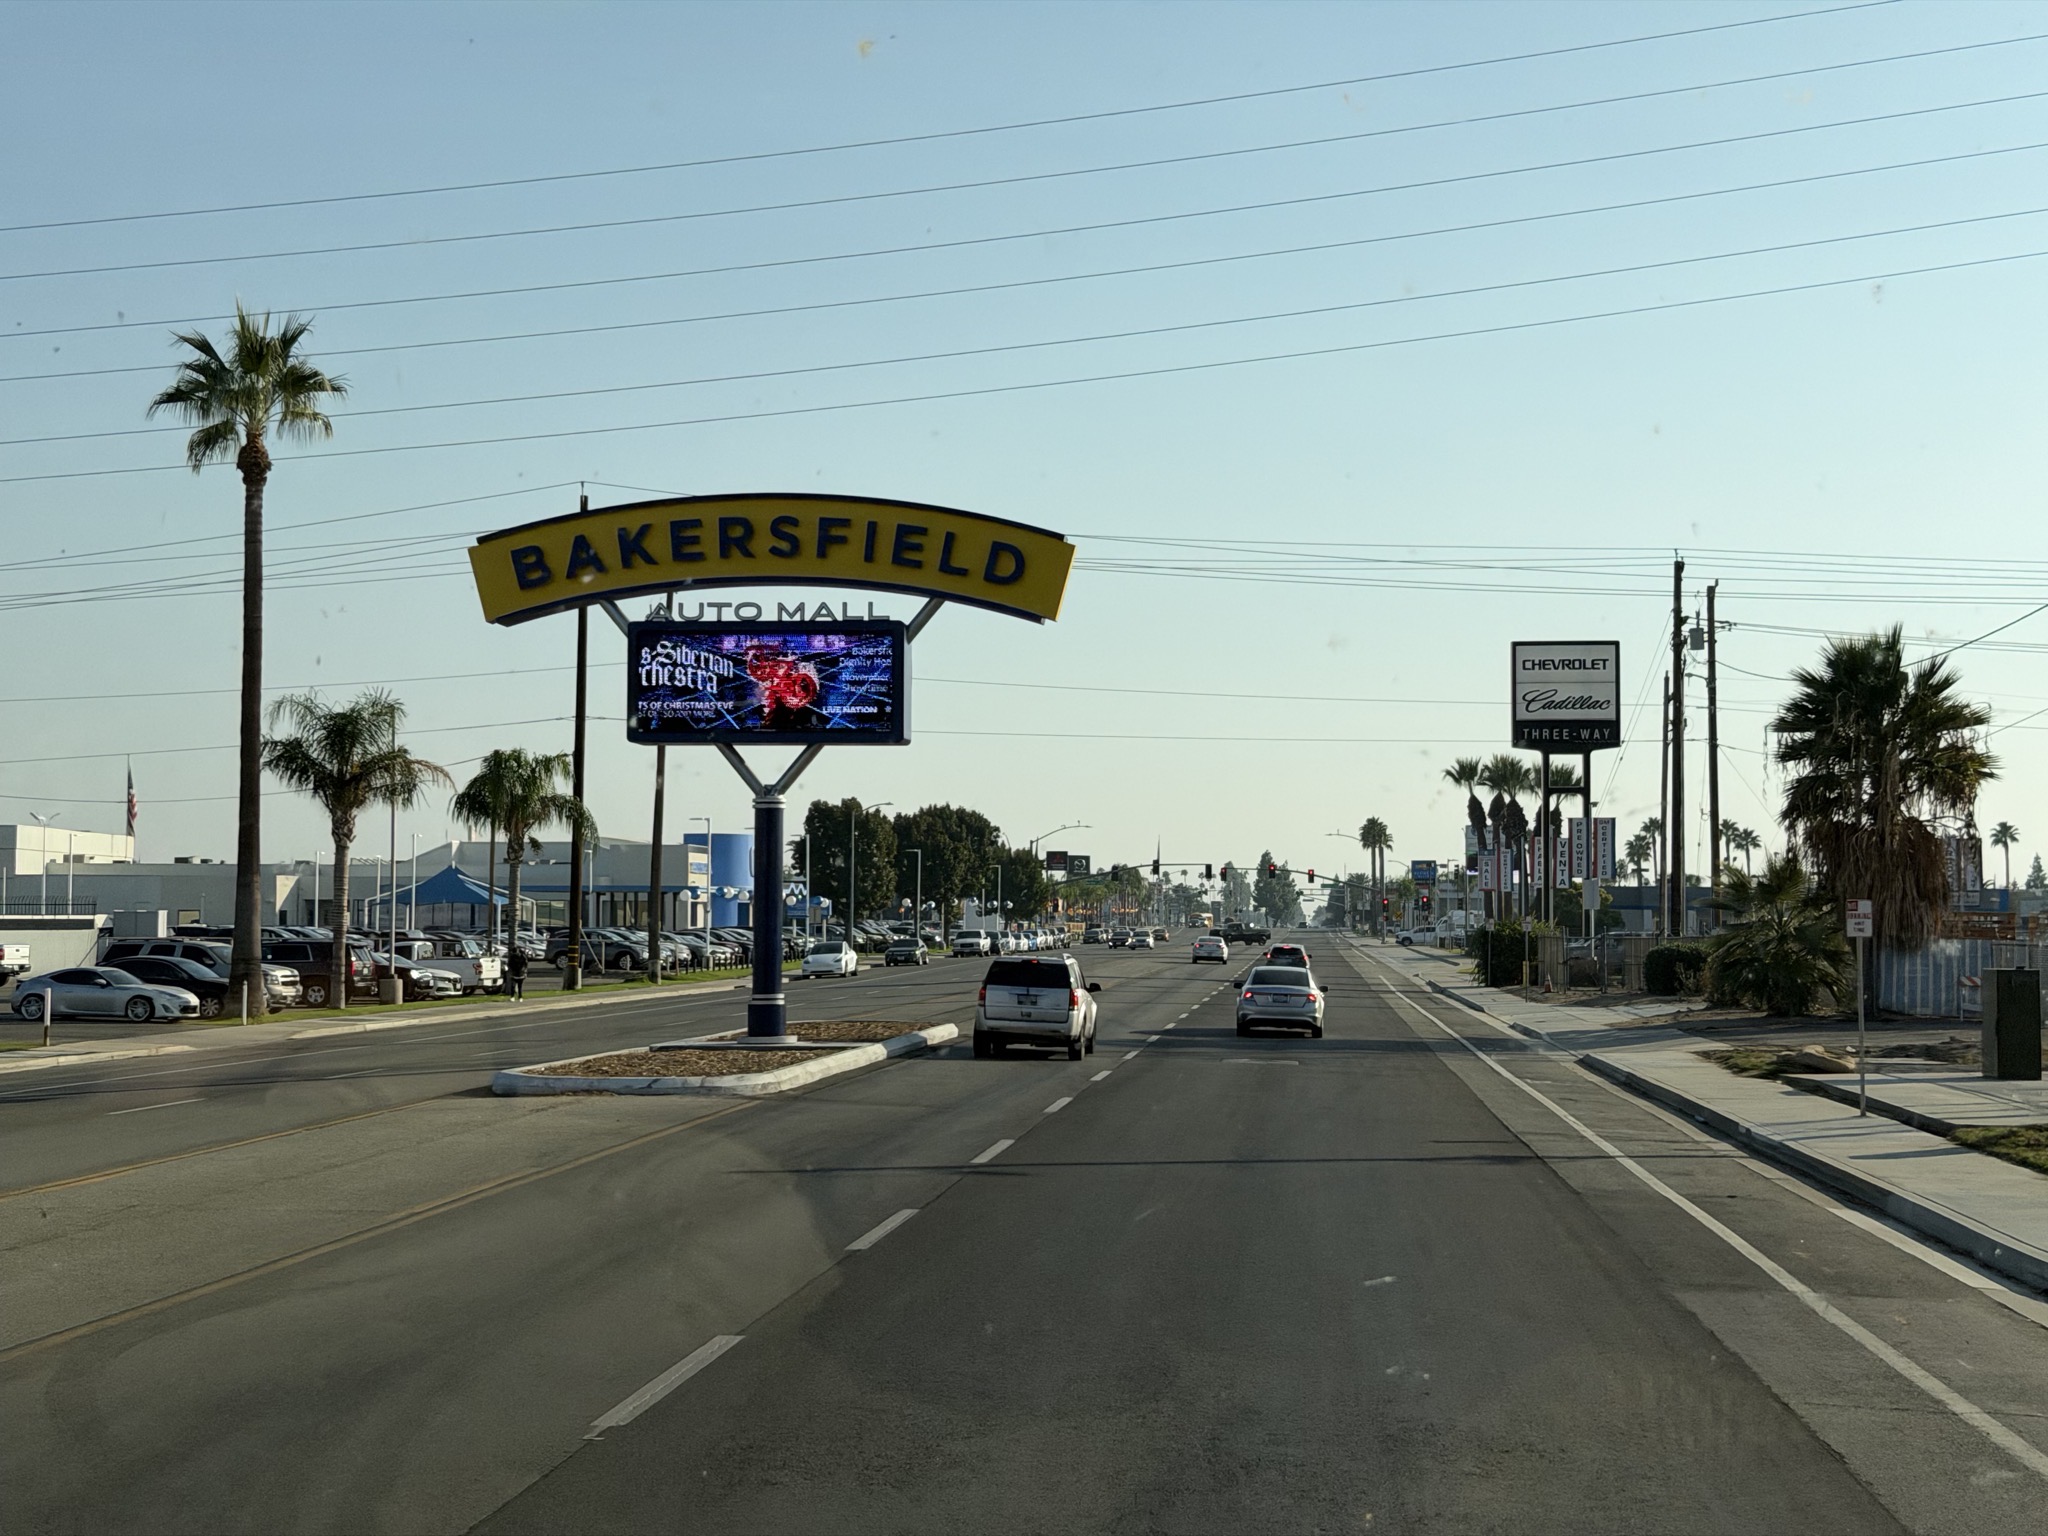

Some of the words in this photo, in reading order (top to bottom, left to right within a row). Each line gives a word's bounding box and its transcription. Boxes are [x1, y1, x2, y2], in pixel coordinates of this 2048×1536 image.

[510, 515, 1026, 590] BAKERSFIELD
[648, 601, 762, 621] AUTO
[777, 601, 890, 621] MALL
[652, 641, 734, 678] Siberian
[1522, 658, 1609, 671] CHEVROLET
[639, 658, 718, 693] chestra
[649, 701, 662, 709] OF
[663, 701, 715, 710] CHRISTMAS
[716, 701, 734, 710] EVE
[1522, 689, 1611, 713] Cadillac
[1523, 728, 1610, 740] THREE-WAY
[1558, 841, 1567, 886] VENTA
